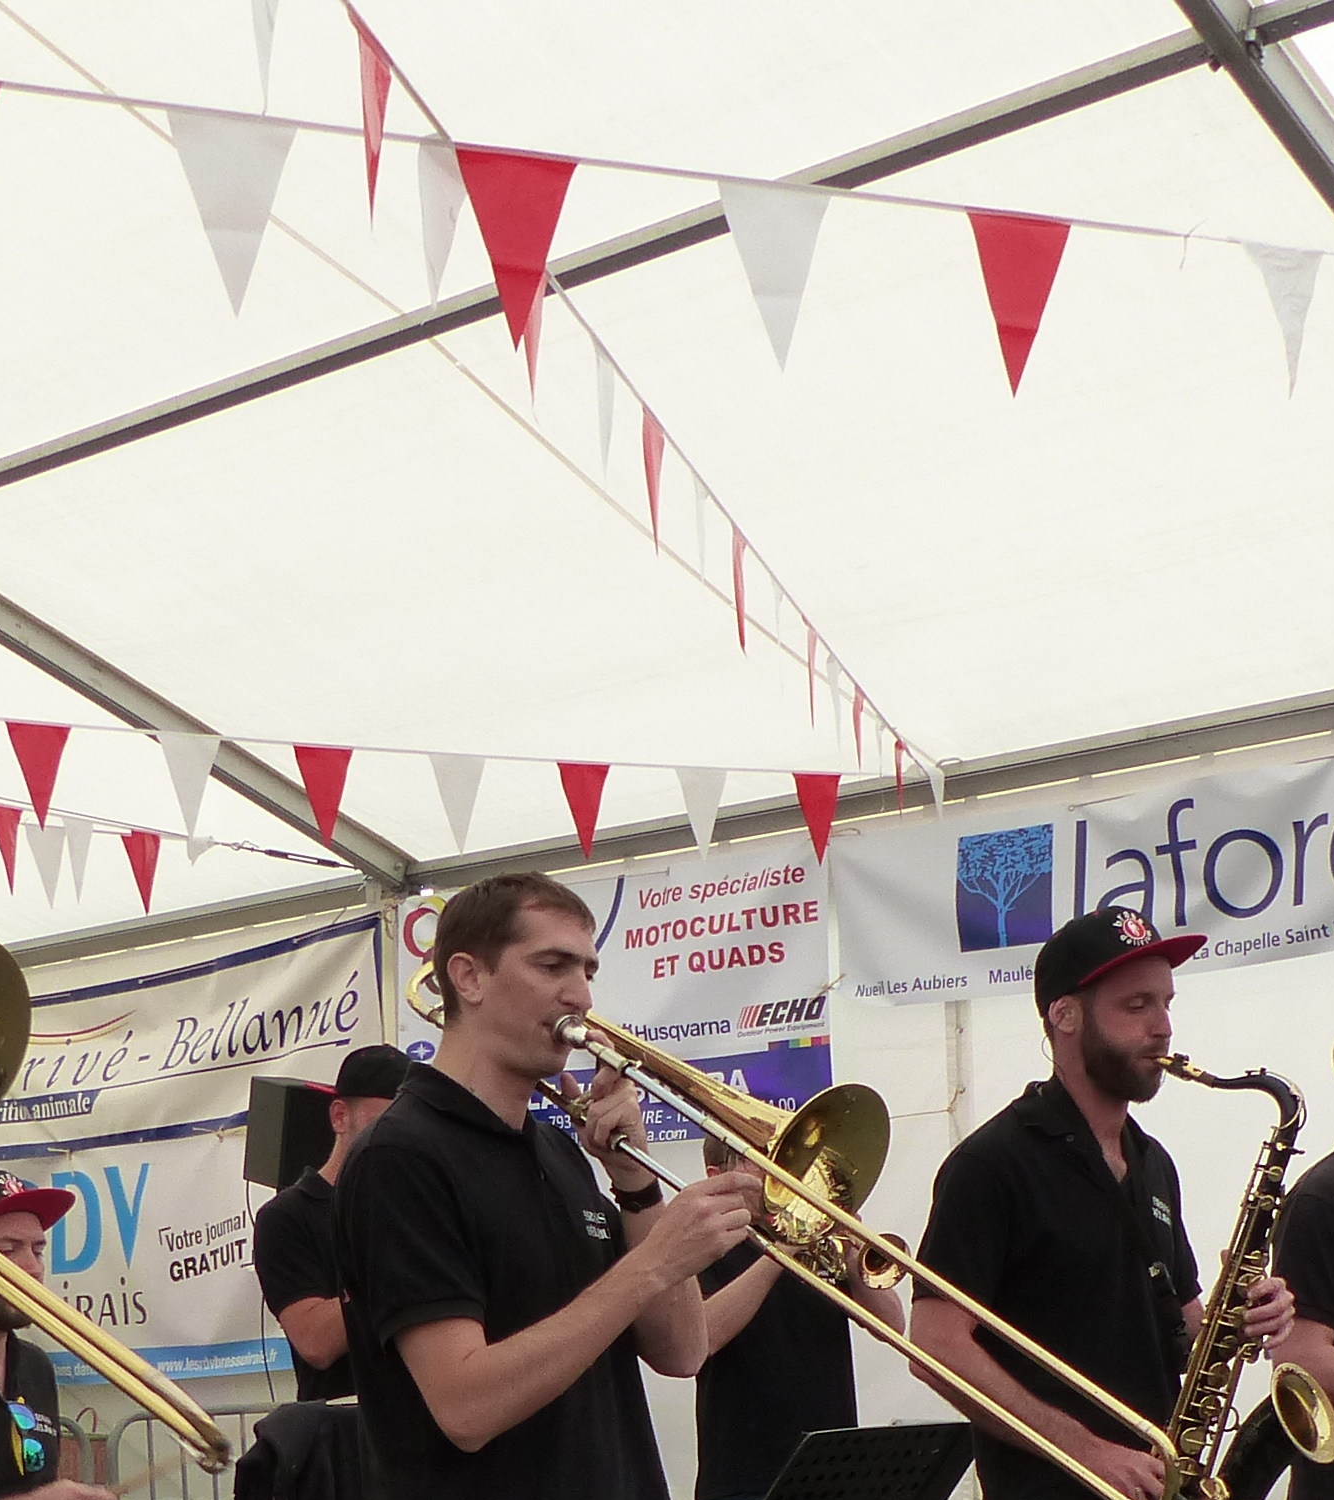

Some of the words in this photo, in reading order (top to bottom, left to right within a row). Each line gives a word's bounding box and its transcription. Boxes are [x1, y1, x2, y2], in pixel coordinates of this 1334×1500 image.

[639, 884, 683, 910] Votre
[688, 866, 806, 903] spécialiste
[625, 900, 819, 950] MOTOCULTURE
[653, 955, 680, 980] ET
[687, 941, 786, 974] QUADS
[855, 980, 886, 998] Nueil
[887, 974, 908, 995] Les
[911, 974, 968, 992] Aubiers
[988, 962, 1035, 985] Maulé
[1214, 931, 1281, 961] Chapelle
[1285, 923, 1330, 945] Saint
[21, 1029, 134, 1092] rivé
[158, 969, 361, 1073] Bellanné
[635, 1019, 731, 1043] Husqvarna
[755, 996, 826, 1028] ECHO
[31, 1092, 91, 1119] animale
[165, 1230, 203, 1252] Votre
[205, 1210, 247, 1246] journal
[169, 1238, 247, 1282] GRATUIT
